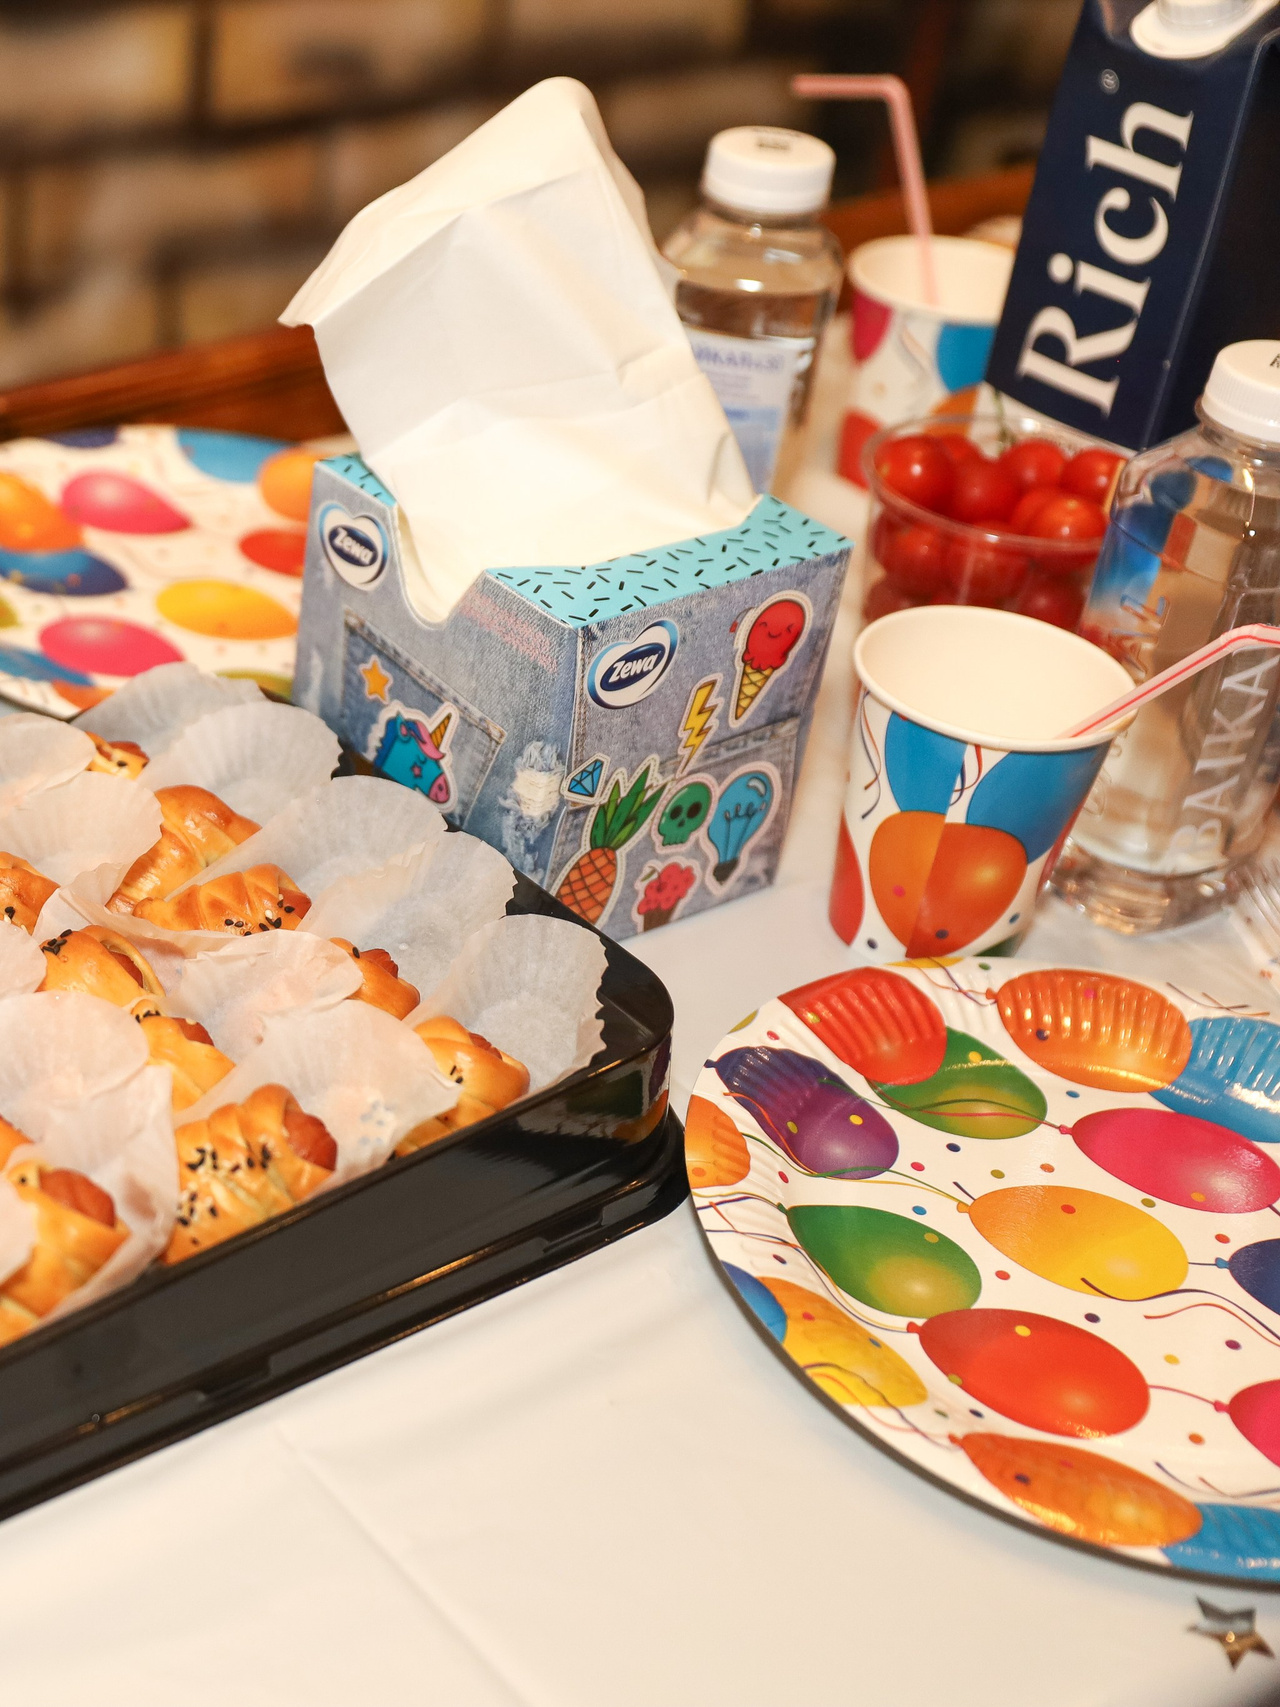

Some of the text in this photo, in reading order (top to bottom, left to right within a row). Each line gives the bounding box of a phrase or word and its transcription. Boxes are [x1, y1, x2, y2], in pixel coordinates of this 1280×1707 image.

[1015, 101, 1194, 420] Rich
[333, 526, 374, 566] Zewa
[608, 653, 660, 683] Zewa
[1166, 645, 1280, 856] BAIKA
